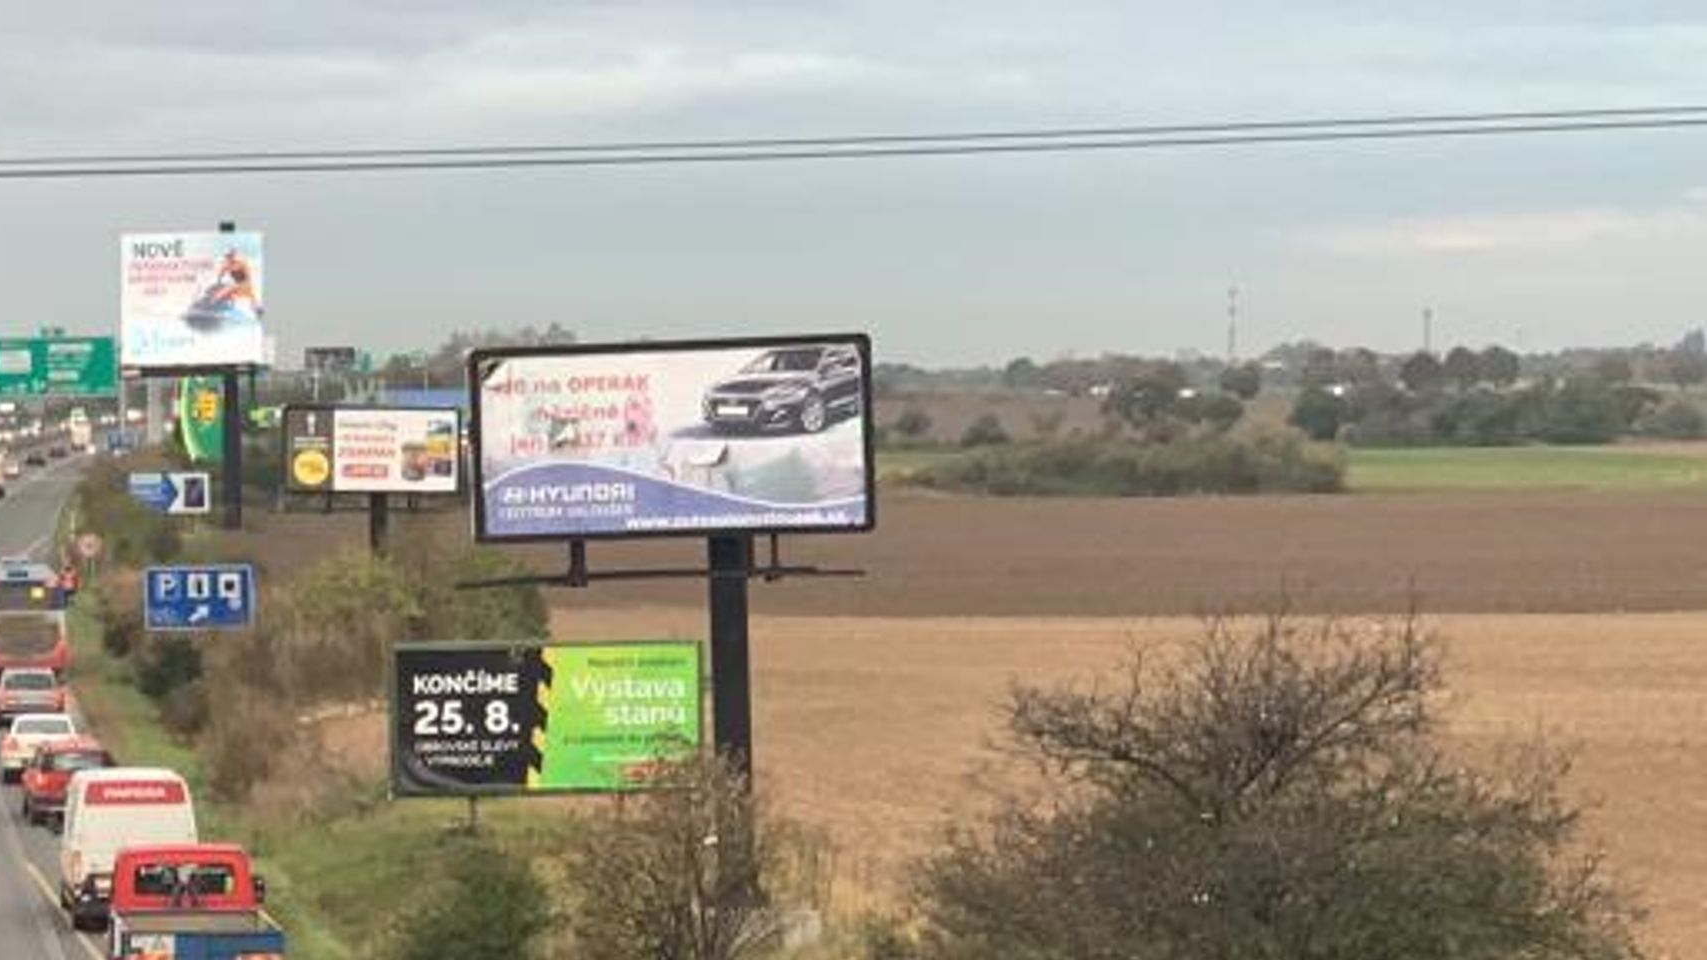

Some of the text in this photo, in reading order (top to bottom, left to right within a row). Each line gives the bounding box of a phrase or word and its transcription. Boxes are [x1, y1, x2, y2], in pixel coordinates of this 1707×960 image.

[529, 482, 636, 503] HYUNDAI
[412, 670, 519, 695] KONČÍME
[569, 675, 686, 706] Výstava
[413, 700, 521, 735] 25. 8.
